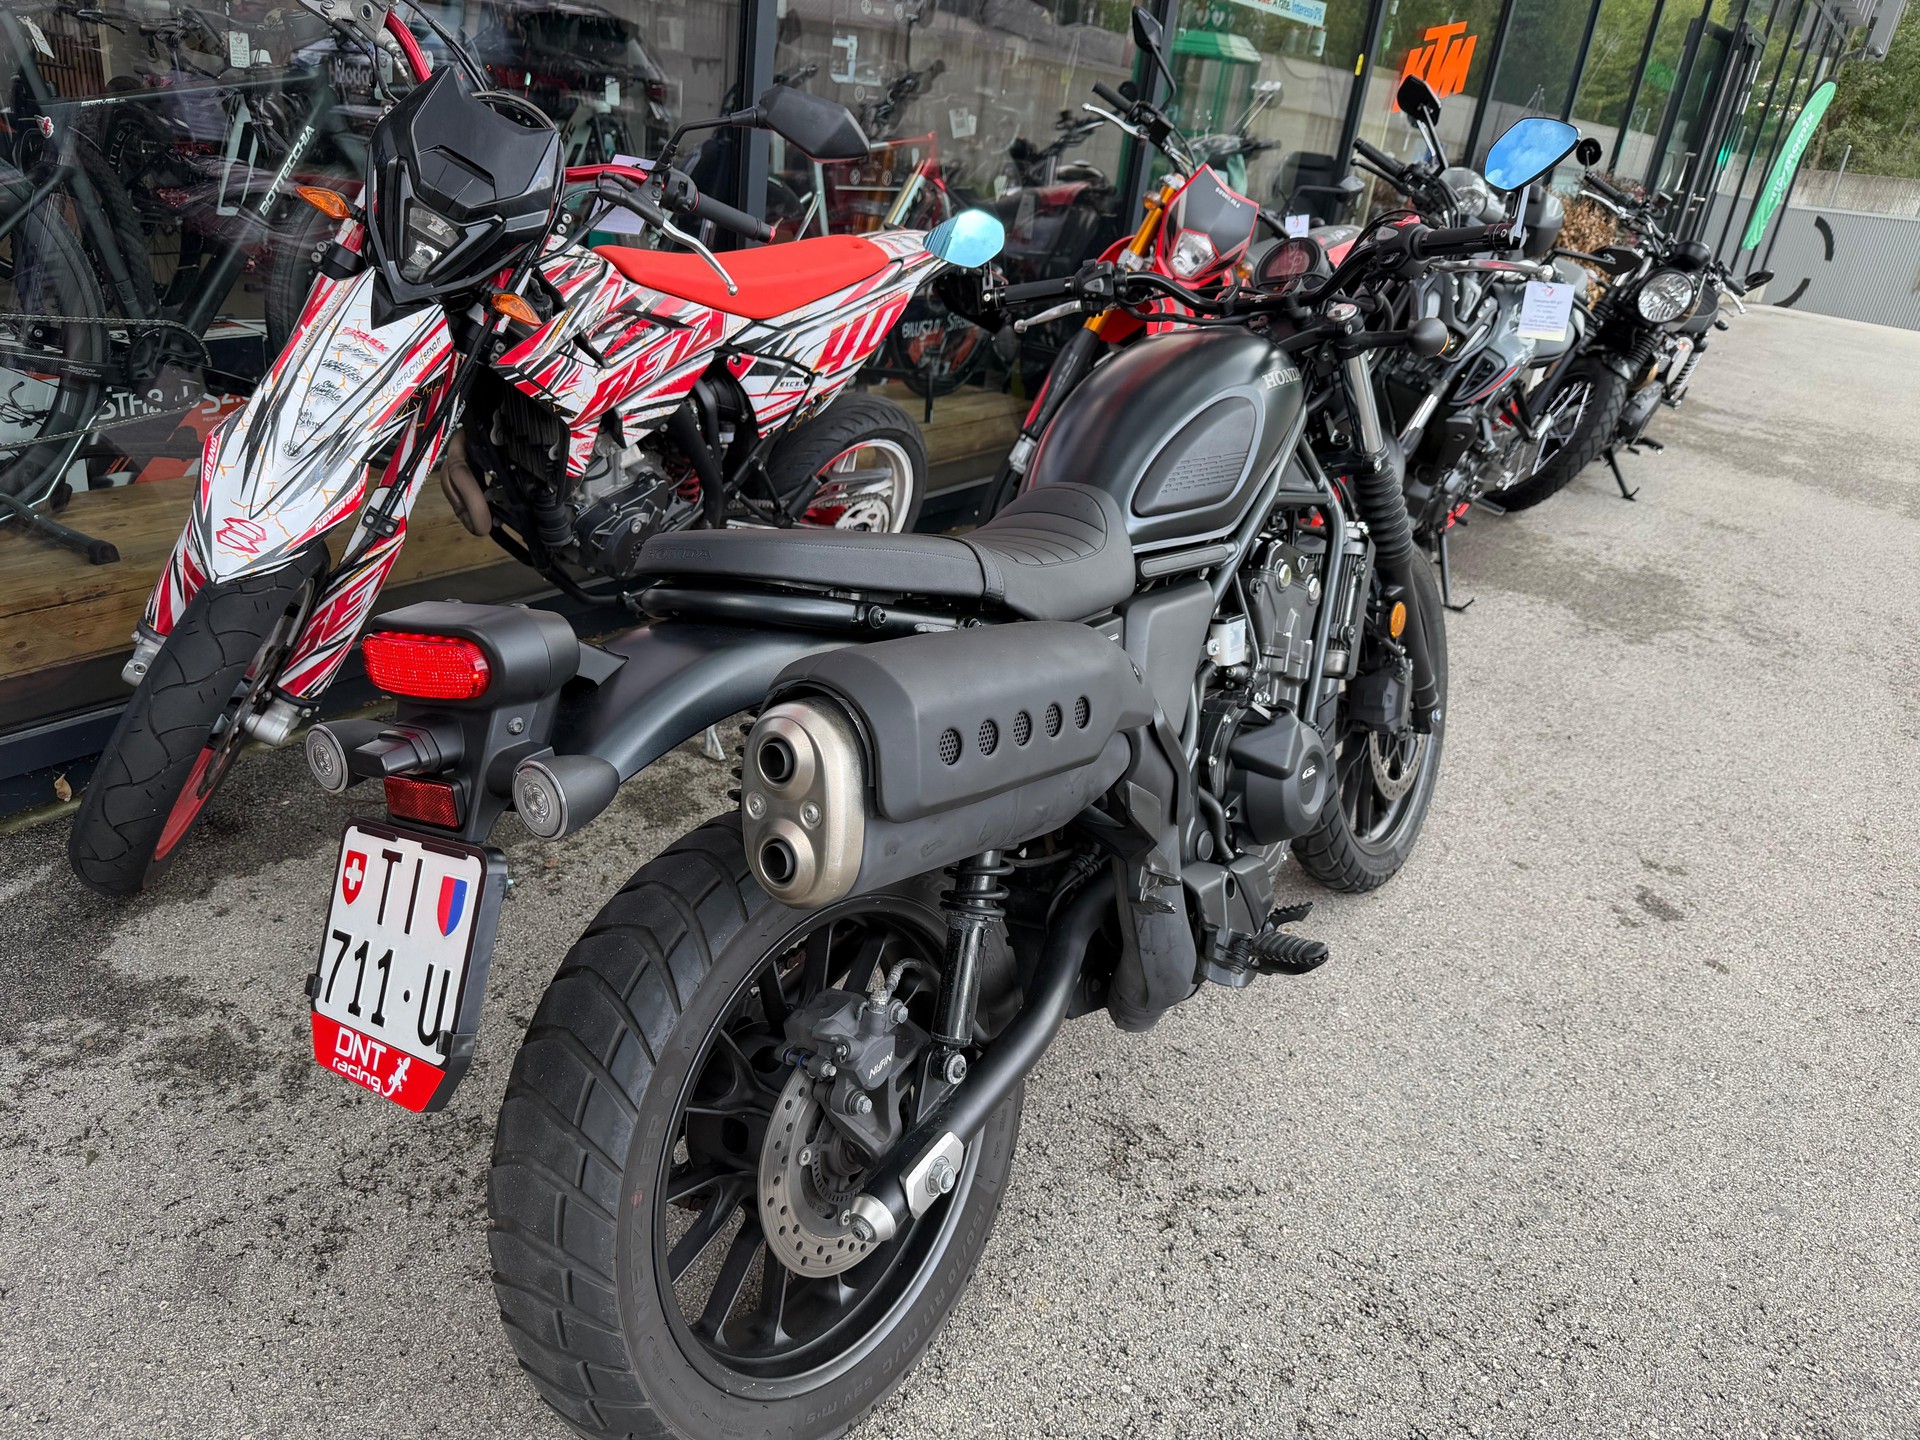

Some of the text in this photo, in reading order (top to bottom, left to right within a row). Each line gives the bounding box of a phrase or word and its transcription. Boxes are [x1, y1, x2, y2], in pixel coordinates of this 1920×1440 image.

[1392, 21, 1478, 113] KTM
[259, 125, 315, 216] BOTTECCHIA
[572, 311, 727, 425] BETA
[315, 501, 345, 533] NEVER
[377, 848, 424, 935] TI
[332, 1058, 382, 1093] racing
[335, 1027, 387, 1072] DNT
[630, 1111, 665, 1331] METZELER
